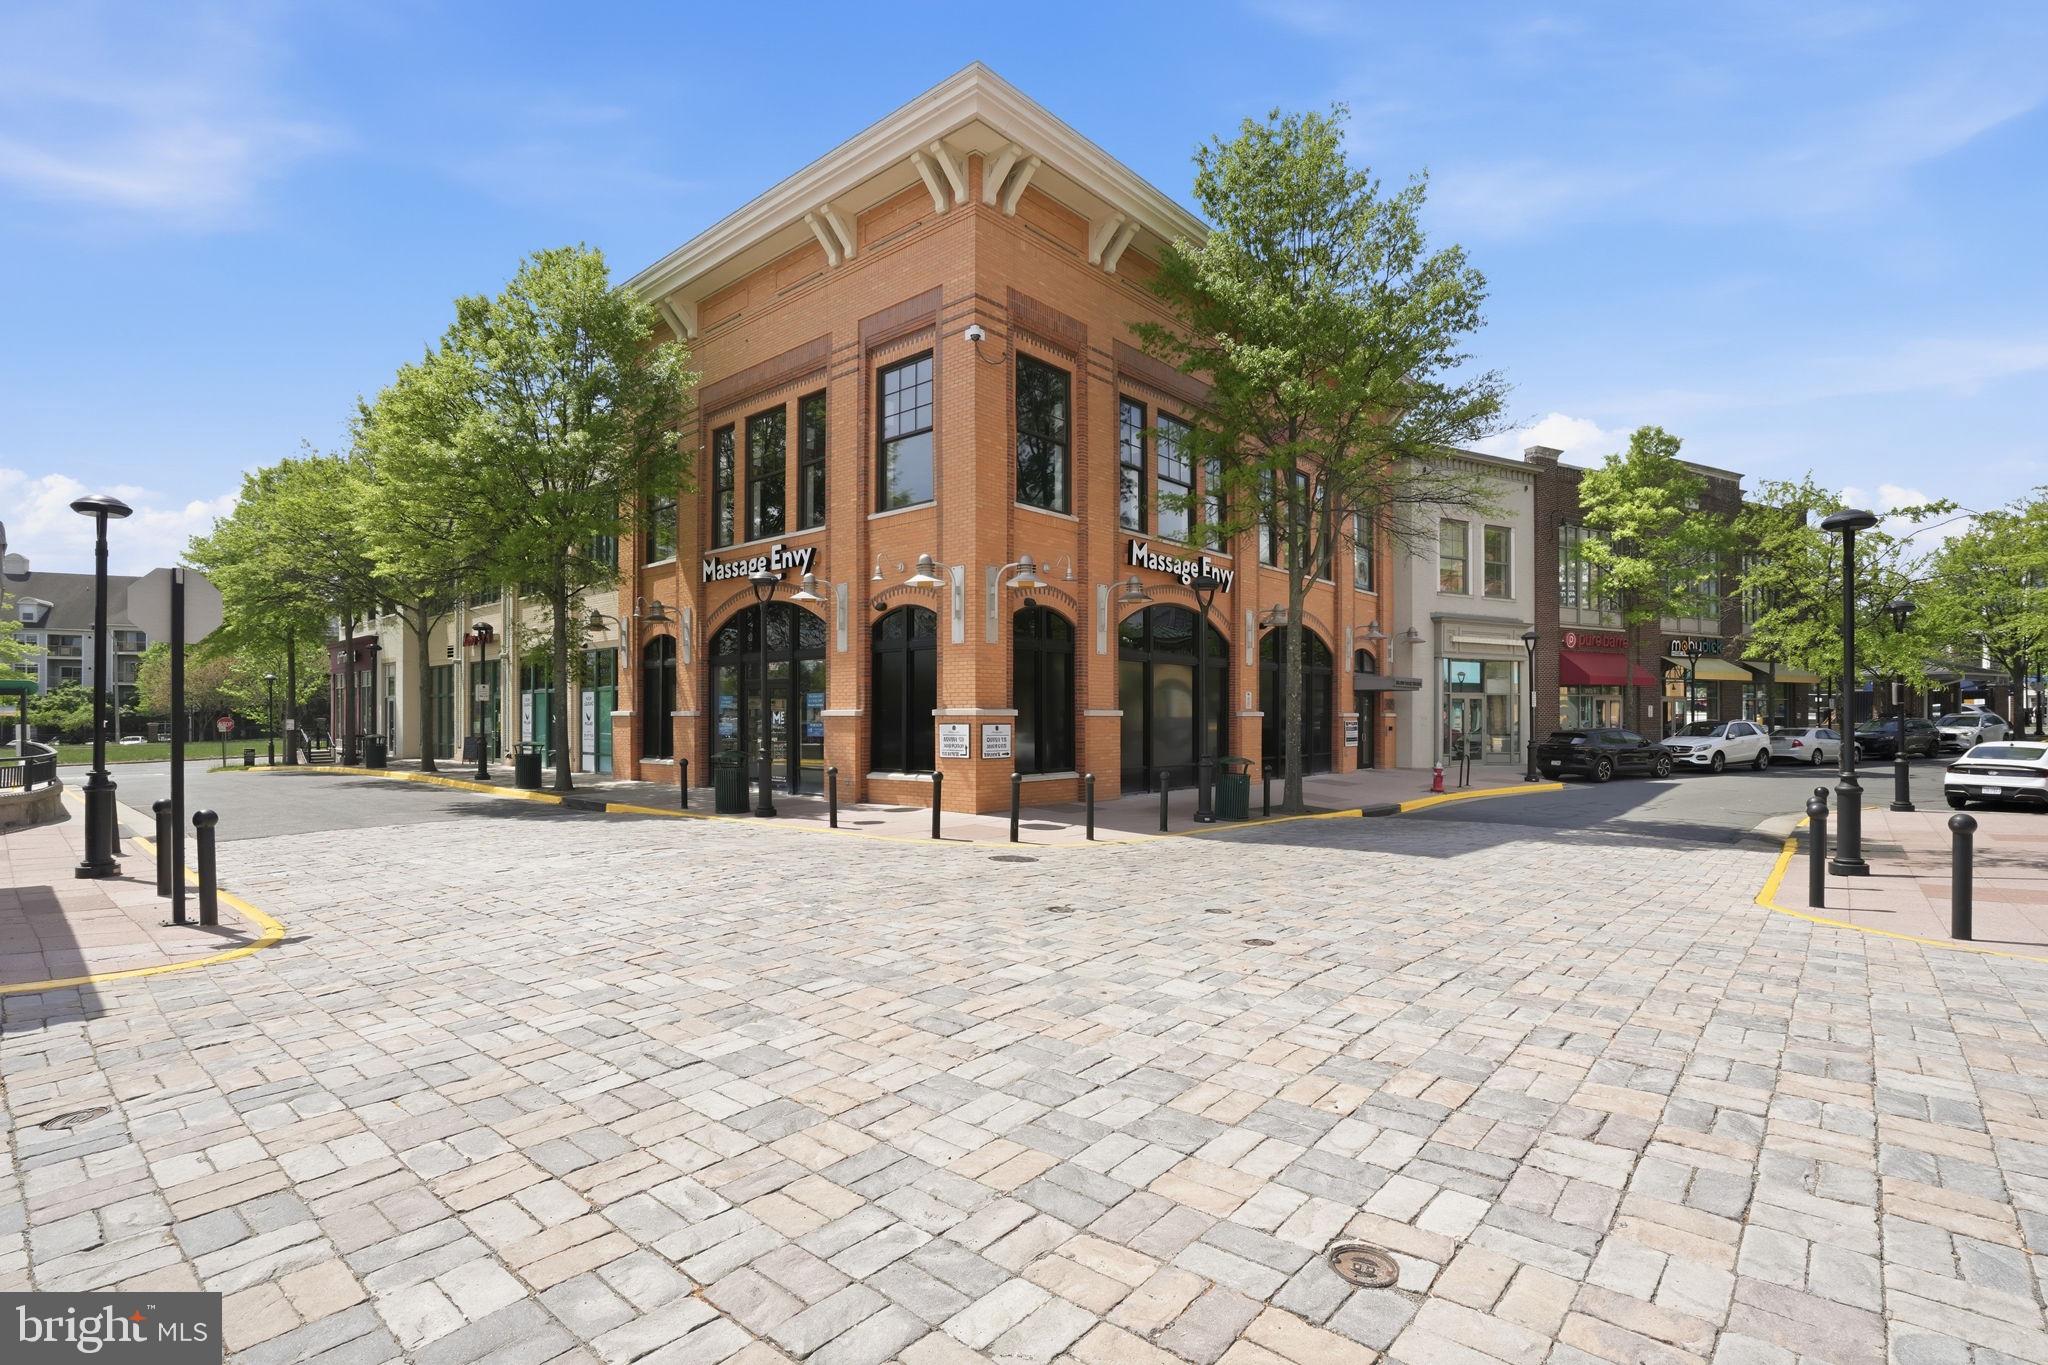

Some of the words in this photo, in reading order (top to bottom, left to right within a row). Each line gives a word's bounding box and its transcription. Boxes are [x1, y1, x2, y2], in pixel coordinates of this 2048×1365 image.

[702, 556, 768, 583] Massage
[771, 544, 814, 576] Envy
[1129, 539, 1199, 585] Massage
[1201, 556, 1235, 594] Envy
[1579, 634, 1601, 647] pure
[1603, 634, 1630, 649] barre
